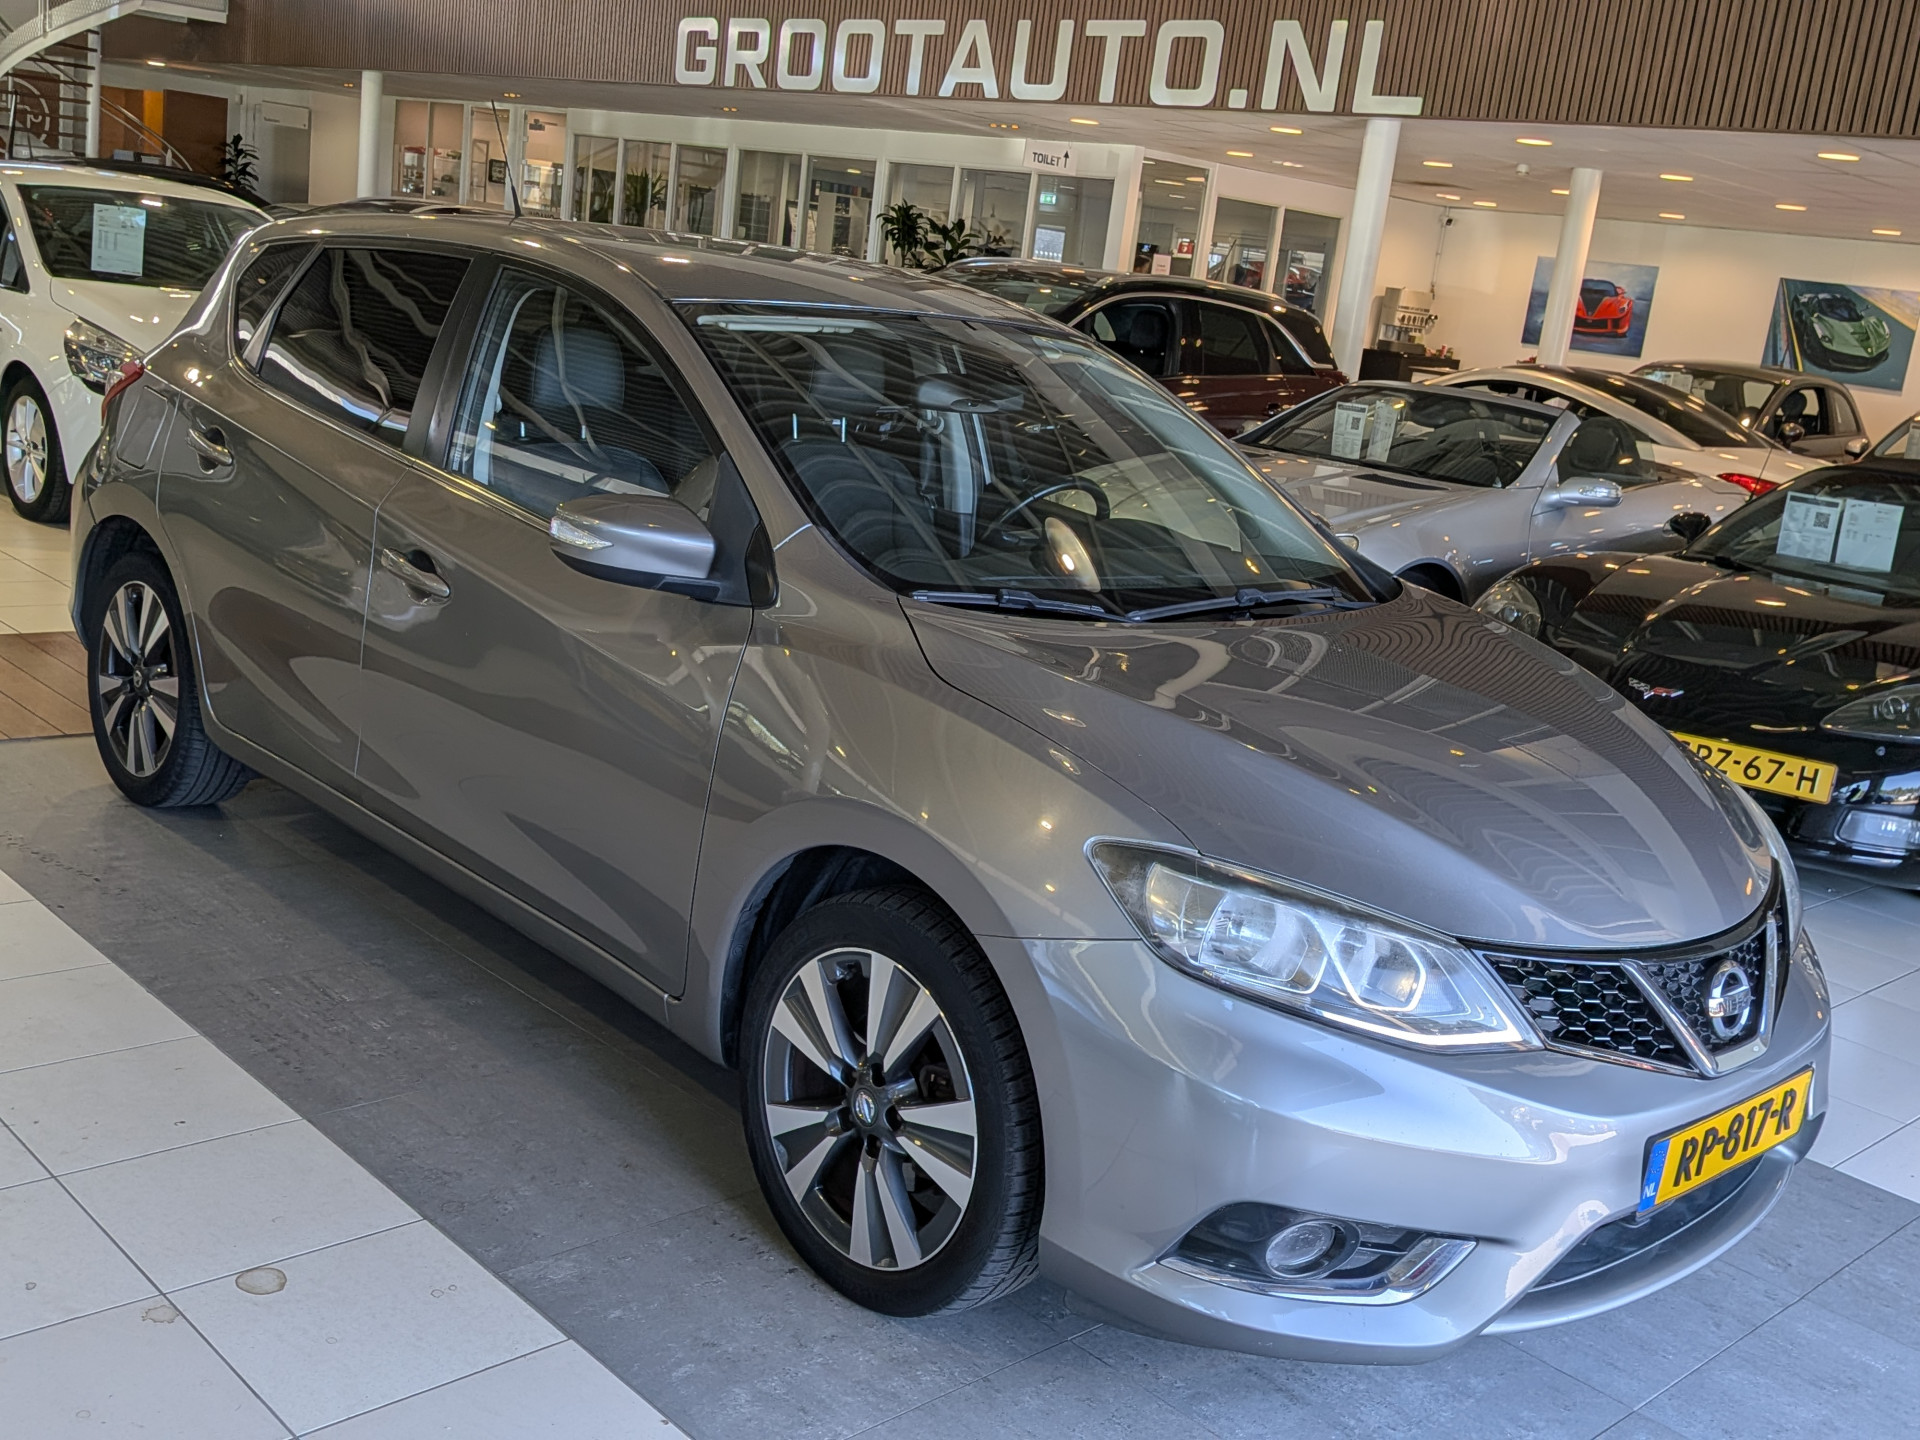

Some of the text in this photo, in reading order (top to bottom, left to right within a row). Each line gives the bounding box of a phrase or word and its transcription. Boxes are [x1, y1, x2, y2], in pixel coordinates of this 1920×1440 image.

[675, 17, 1423, 116] GROOTAUTO.NL
[1032, 151, 1061, 167] TOILET
[1680, 741, 1820, 794] Z-67-H
[1673, 1088, 1797, 1187] RP-817-R
[1643, 1183, 1656, 1199] NL
